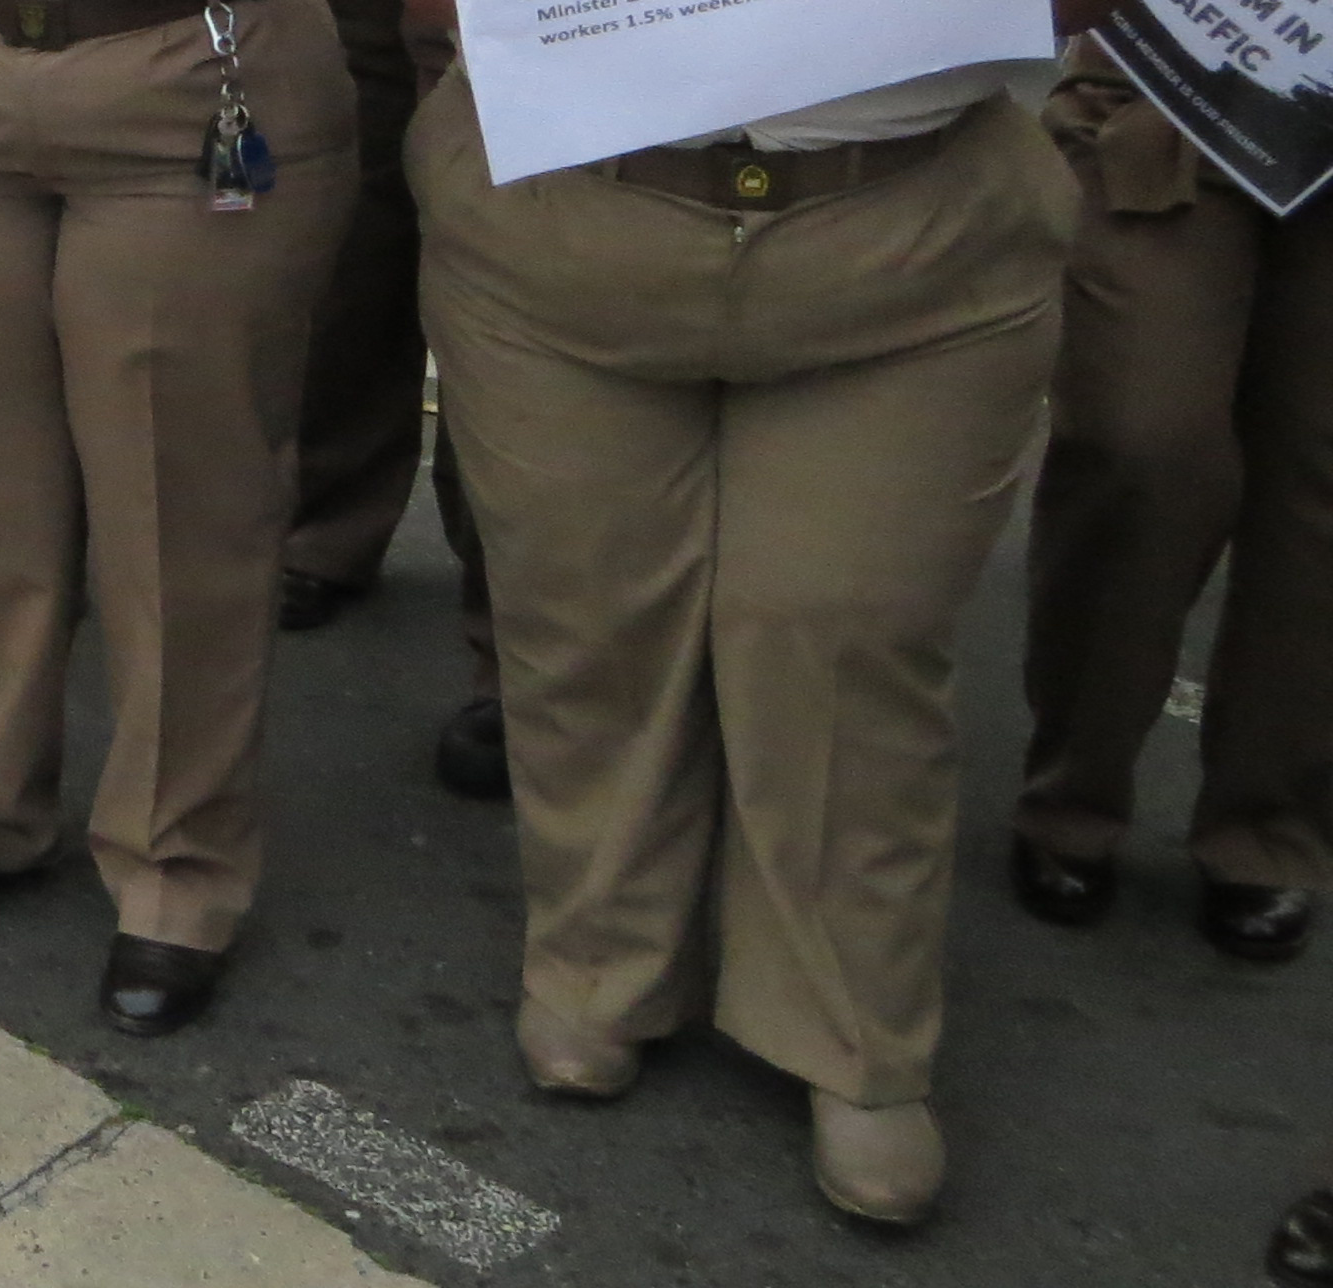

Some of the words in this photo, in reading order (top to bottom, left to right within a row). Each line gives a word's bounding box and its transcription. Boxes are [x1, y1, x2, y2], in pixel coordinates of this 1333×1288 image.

[539, 18, 620, 45] workers
[626, 7, 673, 29] 1.5%
[1274, 14, 1323, 55] IN
